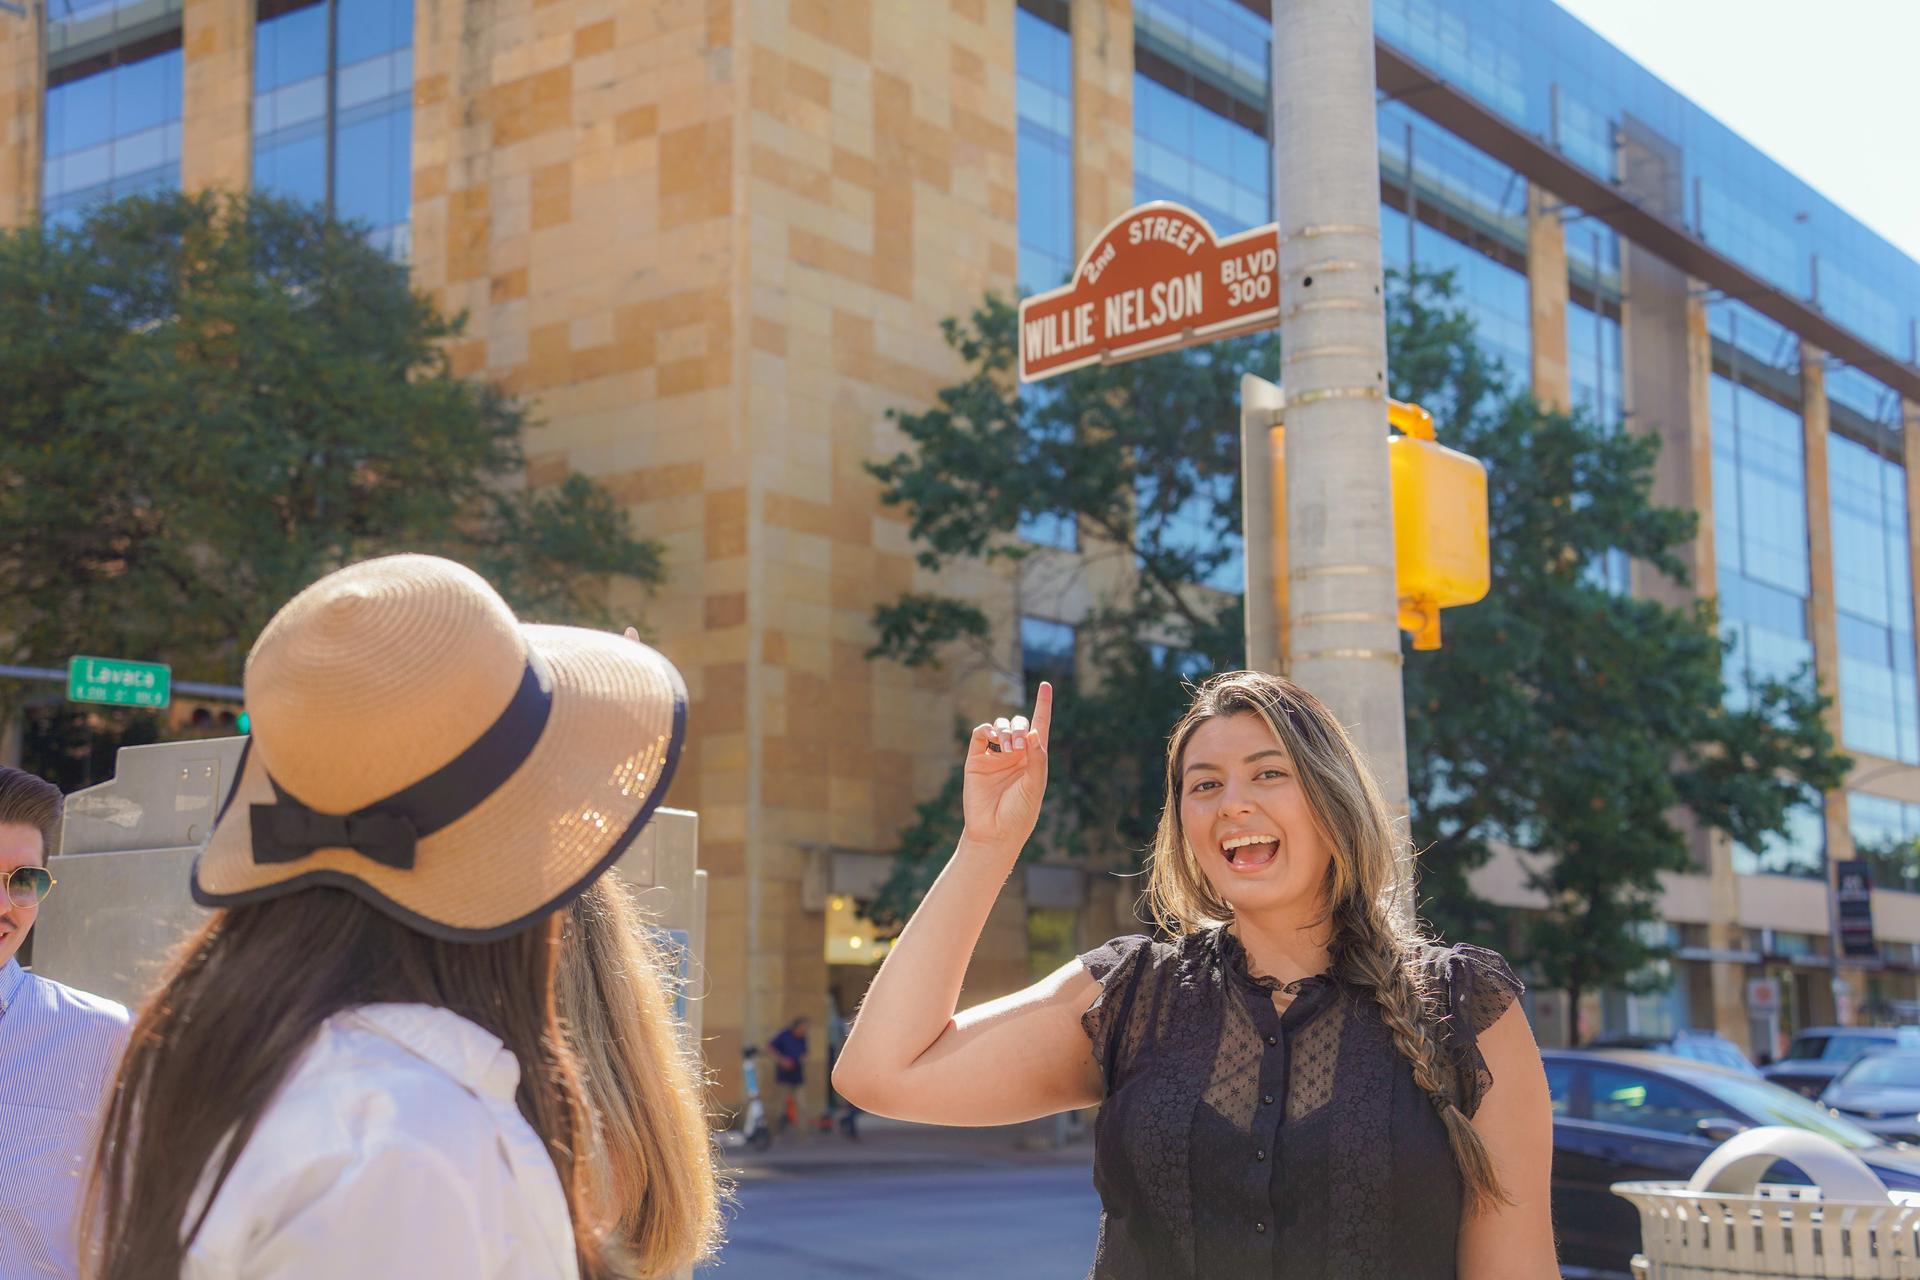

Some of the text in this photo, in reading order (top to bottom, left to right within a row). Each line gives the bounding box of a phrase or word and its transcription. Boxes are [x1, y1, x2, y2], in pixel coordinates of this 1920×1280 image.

[1083, 217, 1205, 284] 2nd STREET
[1221, 248, 1276, 284] BLVD
[1228, 275, 1271, 306] 300
[1025, 272, 1202, 362] WILLIE NELSON
[86, 660, 155, 688] Lavaca
